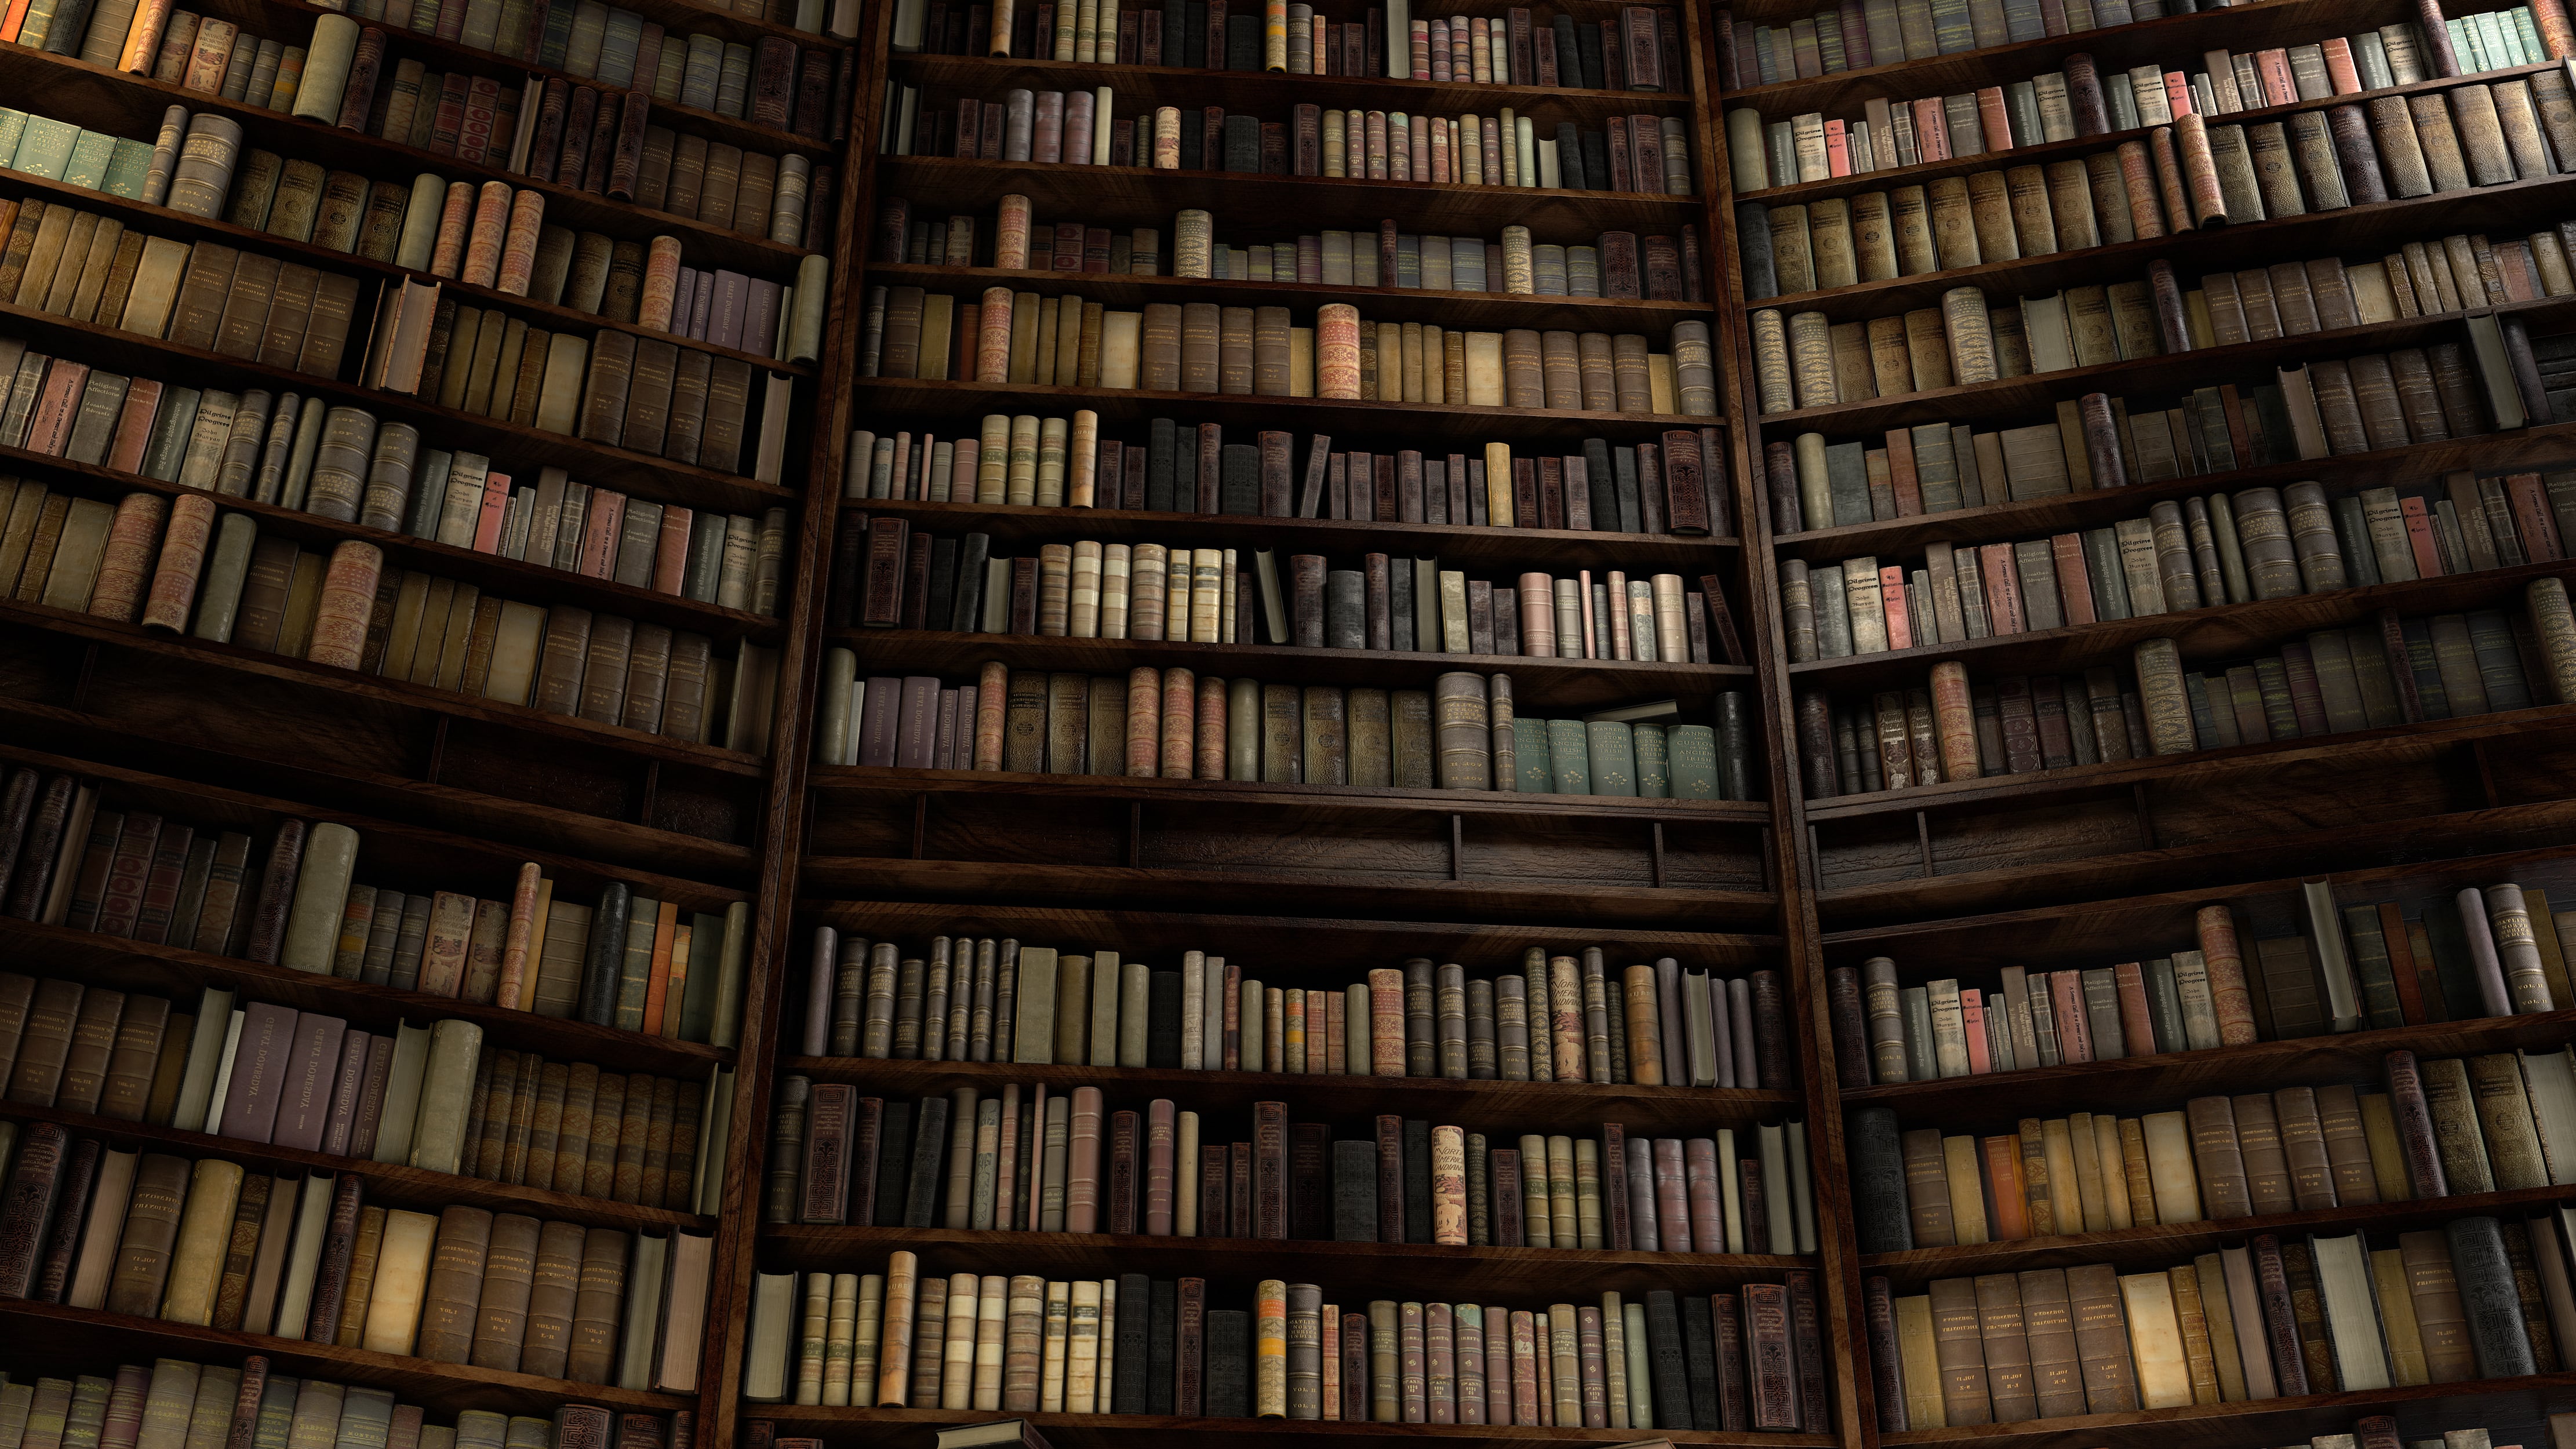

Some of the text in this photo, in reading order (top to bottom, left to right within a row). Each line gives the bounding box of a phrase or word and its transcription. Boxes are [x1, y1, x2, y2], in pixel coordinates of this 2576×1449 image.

[678, 271, 689, 320] GREAT DOMESDAY
[696, 276, 708, 325] GREAT DOMESDAY
[723, 281, 735, 330] GREAT DOMESDAY
[759, 308, 767, 338] DOMESDAY
[88, 380, 120, 390] Religious
[86, 387, 120, 397] Affections
[85, 401, 112, 411] Jonathan
[627, 508, 656, 518] Religious
[625, 515, 656, 525] Affections
[626, 529, 652, 538] Jonathan
